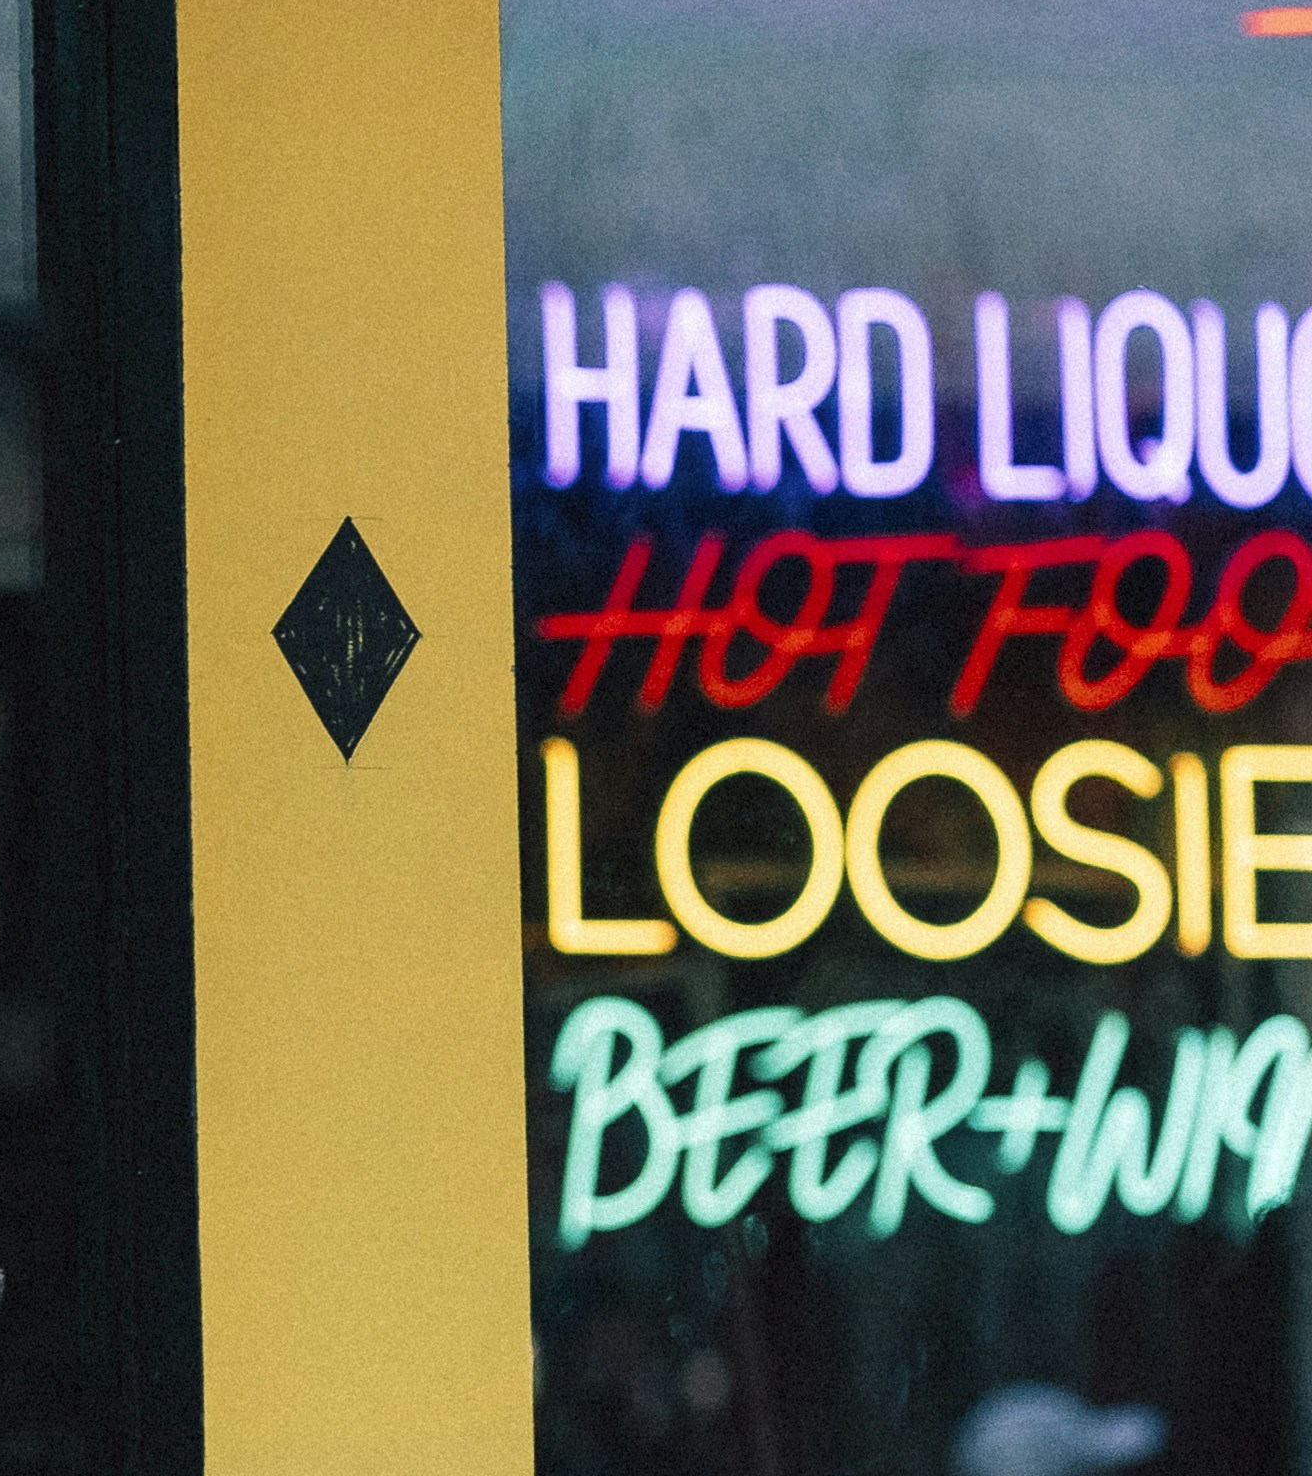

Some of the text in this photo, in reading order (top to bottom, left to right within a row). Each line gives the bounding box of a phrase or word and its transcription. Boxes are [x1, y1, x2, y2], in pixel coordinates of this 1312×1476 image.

[540, 280, 936, 500] HARD
[532, 528, 966, 718] HOT
[542, 737, 1312, 965] LOOSIE
